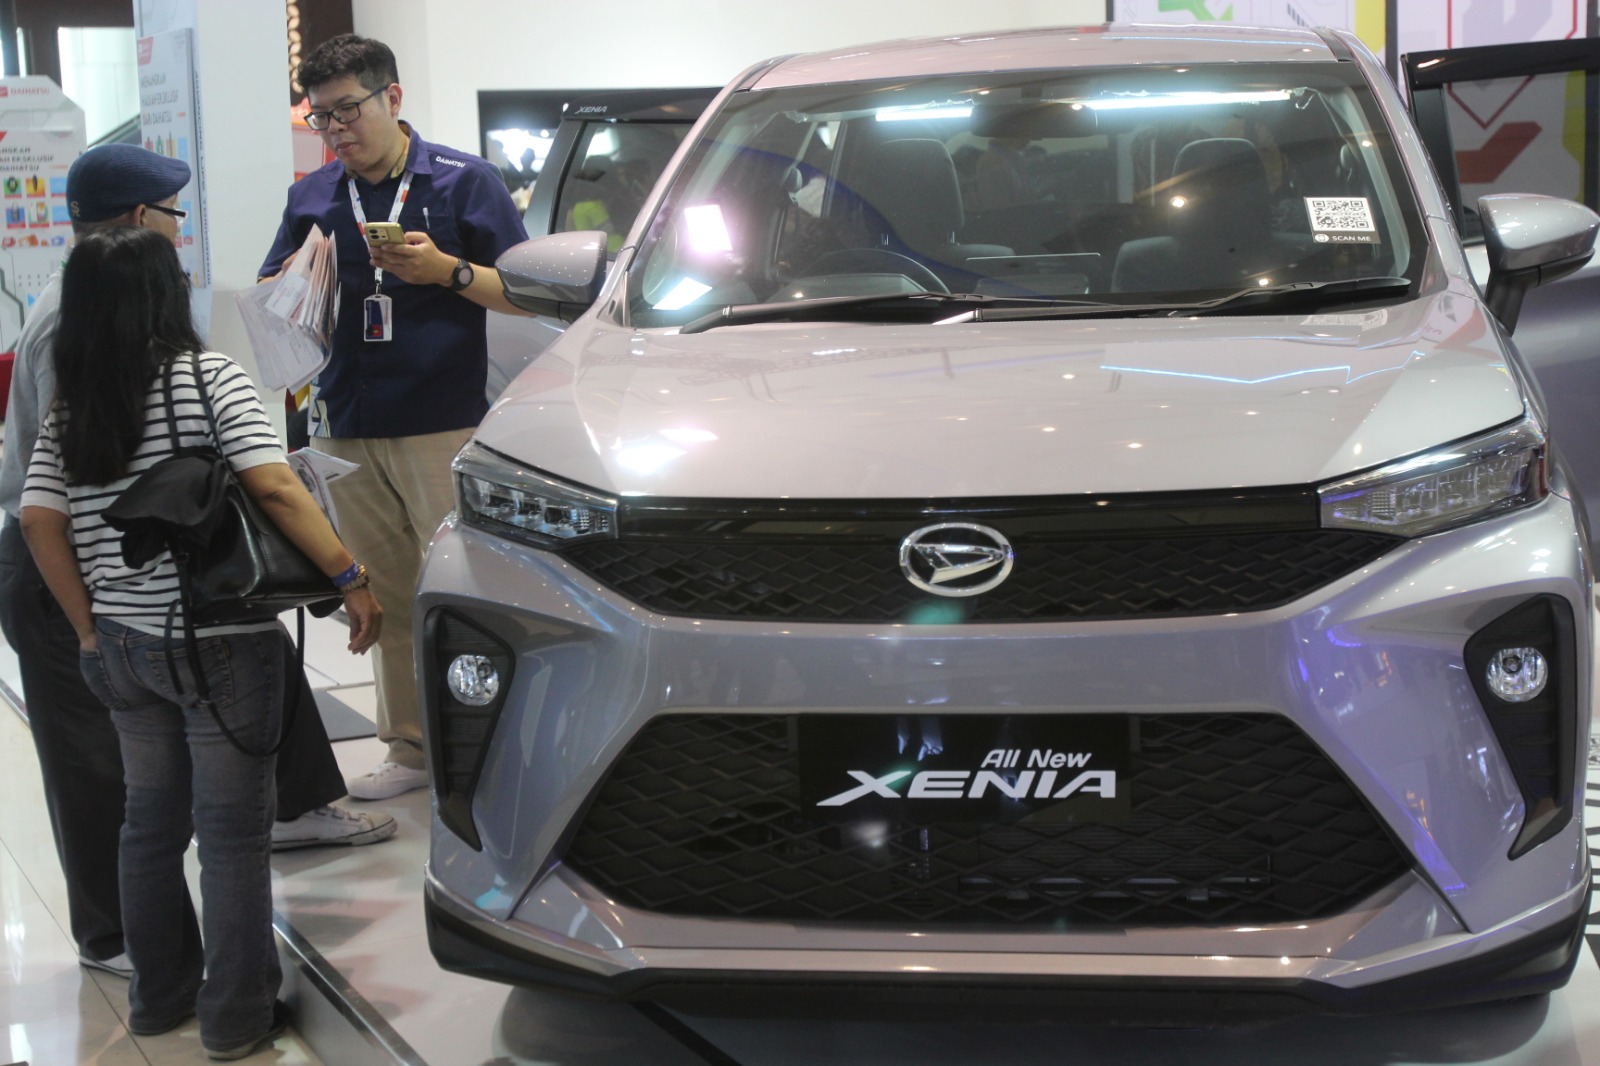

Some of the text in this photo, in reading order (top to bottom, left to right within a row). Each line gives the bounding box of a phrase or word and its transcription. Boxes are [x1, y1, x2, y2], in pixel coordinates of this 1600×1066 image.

[574, 106, 607, 114] XENIA
[436, 156, 466, 168] DAIHATSU
[981, 749, 1092, 768] All New
[816, 771, 1116, 806] XENIA
